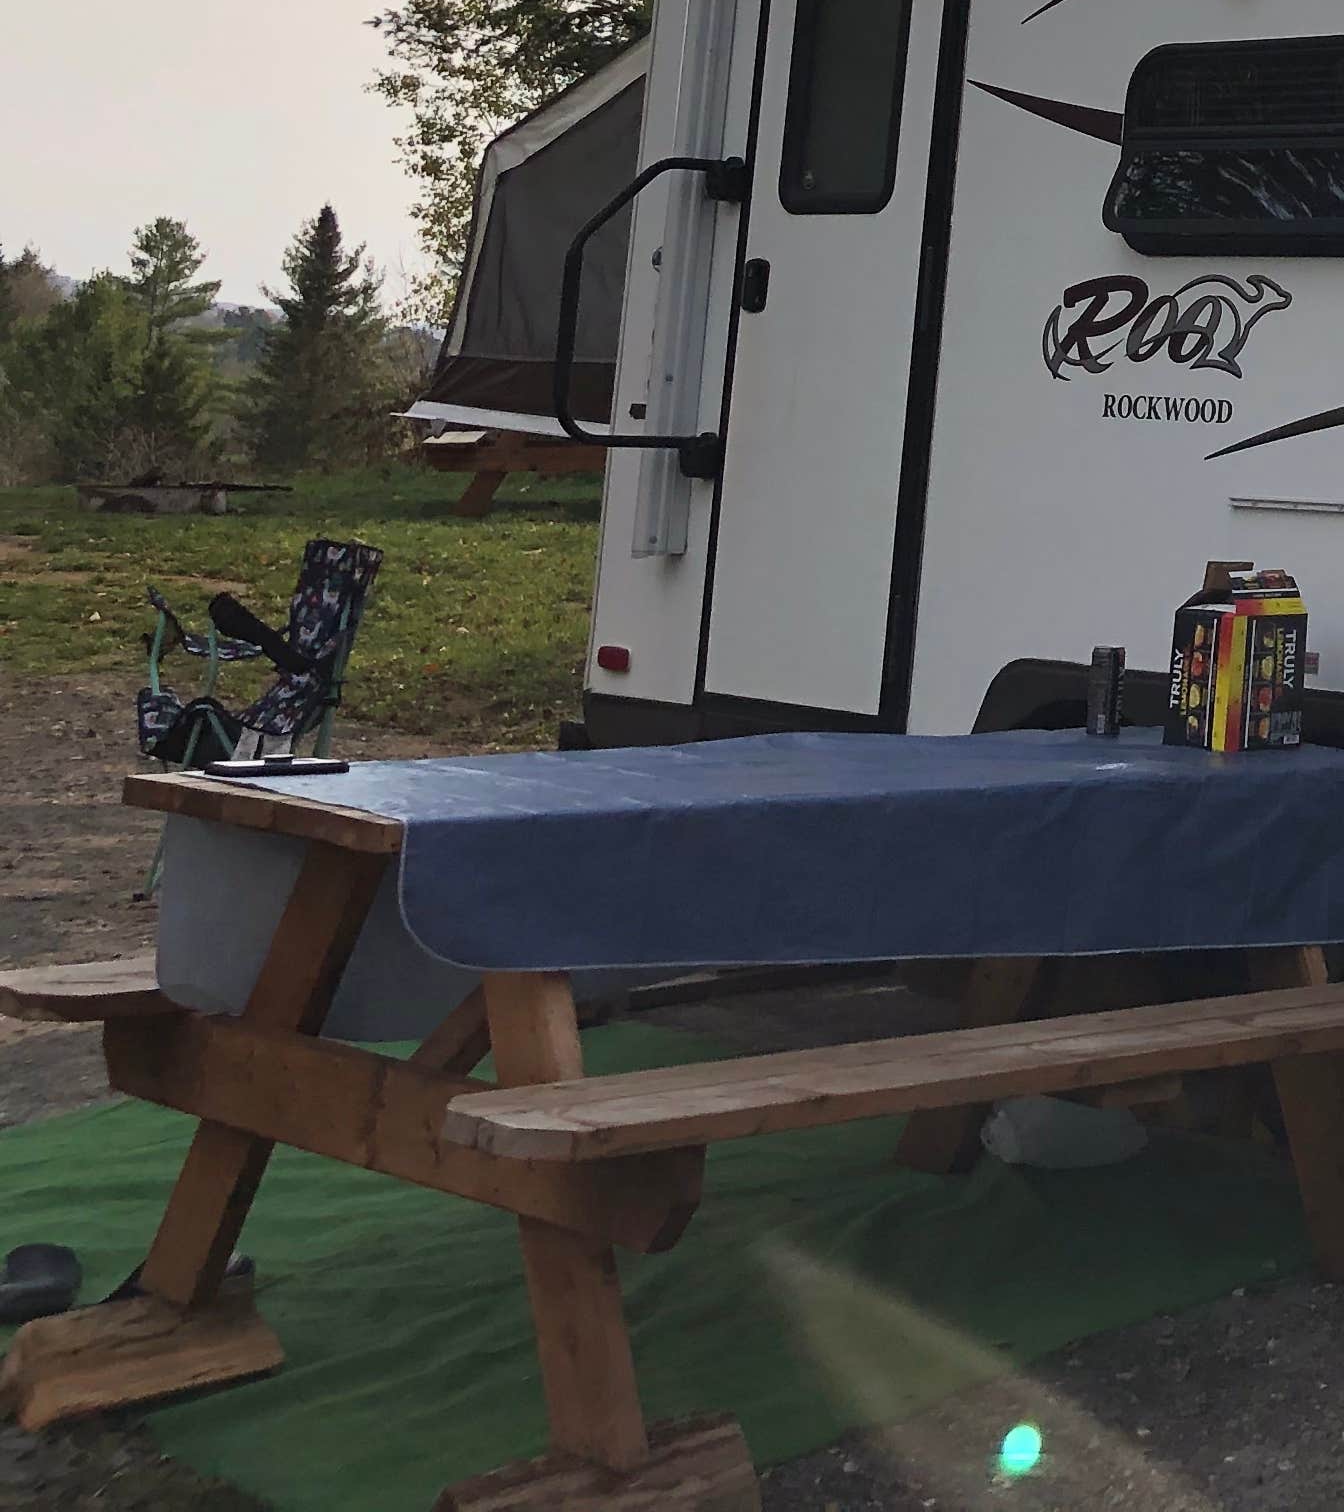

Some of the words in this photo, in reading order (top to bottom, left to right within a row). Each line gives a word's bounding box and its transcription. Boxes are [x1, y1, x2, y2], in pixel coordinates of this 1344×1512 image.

[1102, 393, 1234, 424] ROCKWOOD
[1169, 648, 1185, 709] TRULY
[1283, 629, 1297, 689] TRULY
